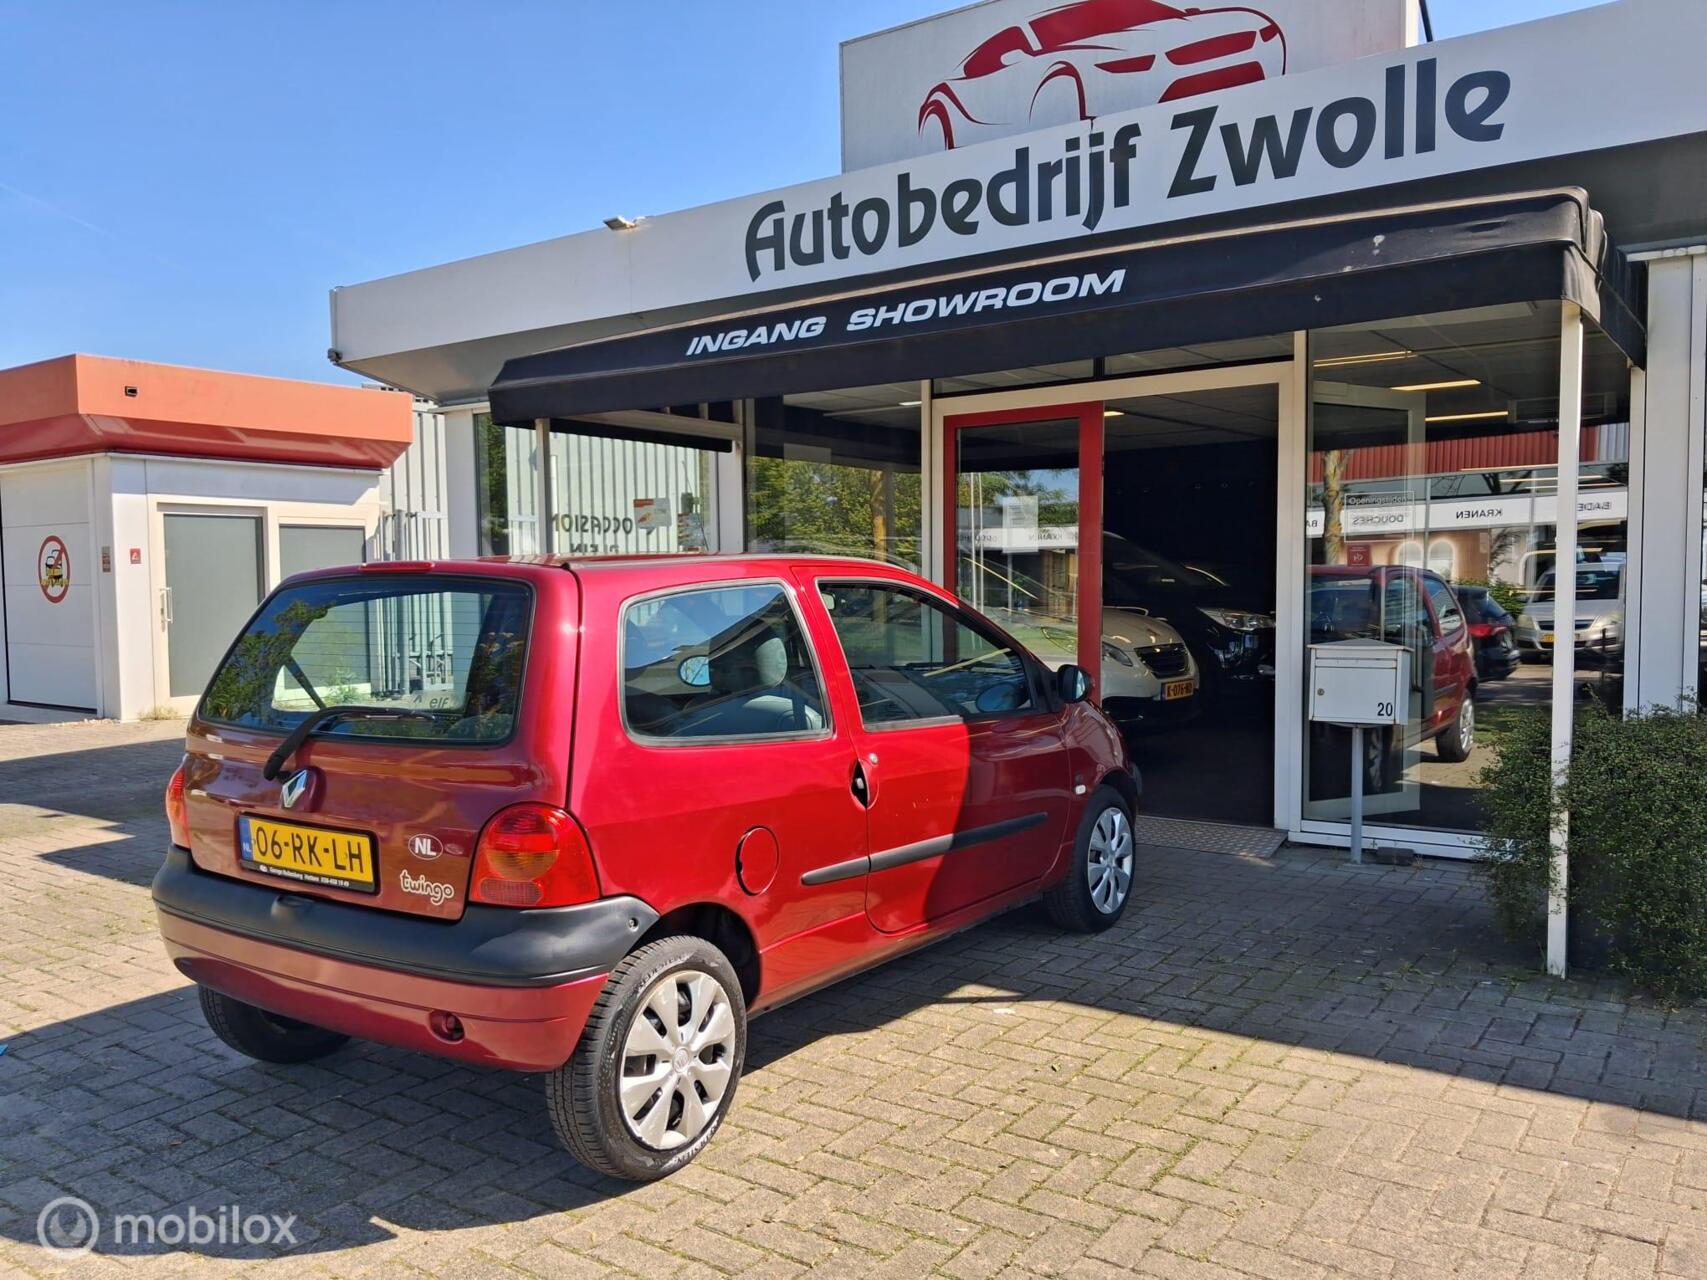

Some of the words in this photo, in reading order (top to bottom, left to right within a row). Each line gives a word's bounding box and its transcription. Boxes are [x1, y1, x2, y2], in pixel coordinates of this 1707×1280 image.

[744, 122, 1141, 283] Autobedrijf
[1166, 57, 1511, 199] Zwolle
[685, 315, 828, 356] INGANG
[846, 268, 1127, 332] SHOWROOM
[429, 696, 449, 708] elf
[1377, 702, 1393, 717] 20
[256, 826, 364, 873] 06-RK-LH
[414, 837, 437, 856] NL
[400, 869, 454, 906] twingo
